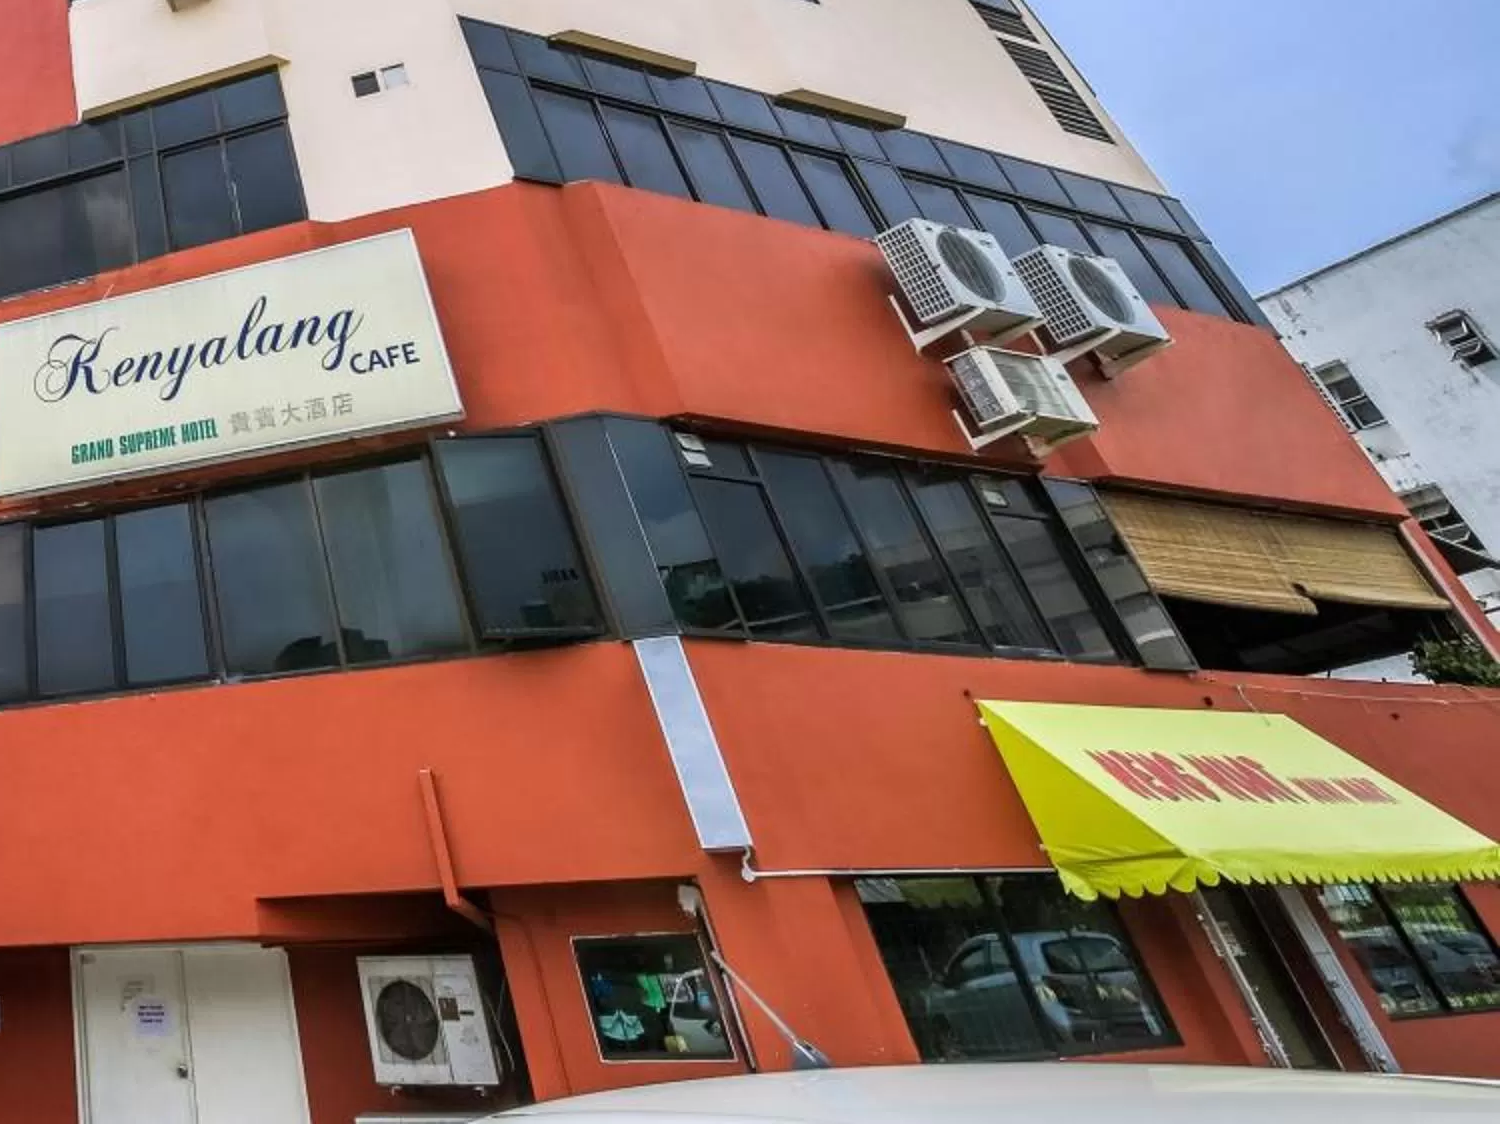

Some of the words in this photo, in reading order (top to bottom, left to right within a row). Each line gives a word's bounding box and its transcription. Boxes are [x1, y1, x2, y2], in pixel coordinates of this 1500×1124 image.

[33, 295, 365, 403] Kenyalang
[349, 341, 421, 375] CAFE
[71, 439, 114, 465] GRAND
[119, 425, 177, 456] SUPREME
[181, 417, 219, 444] HOTEL
